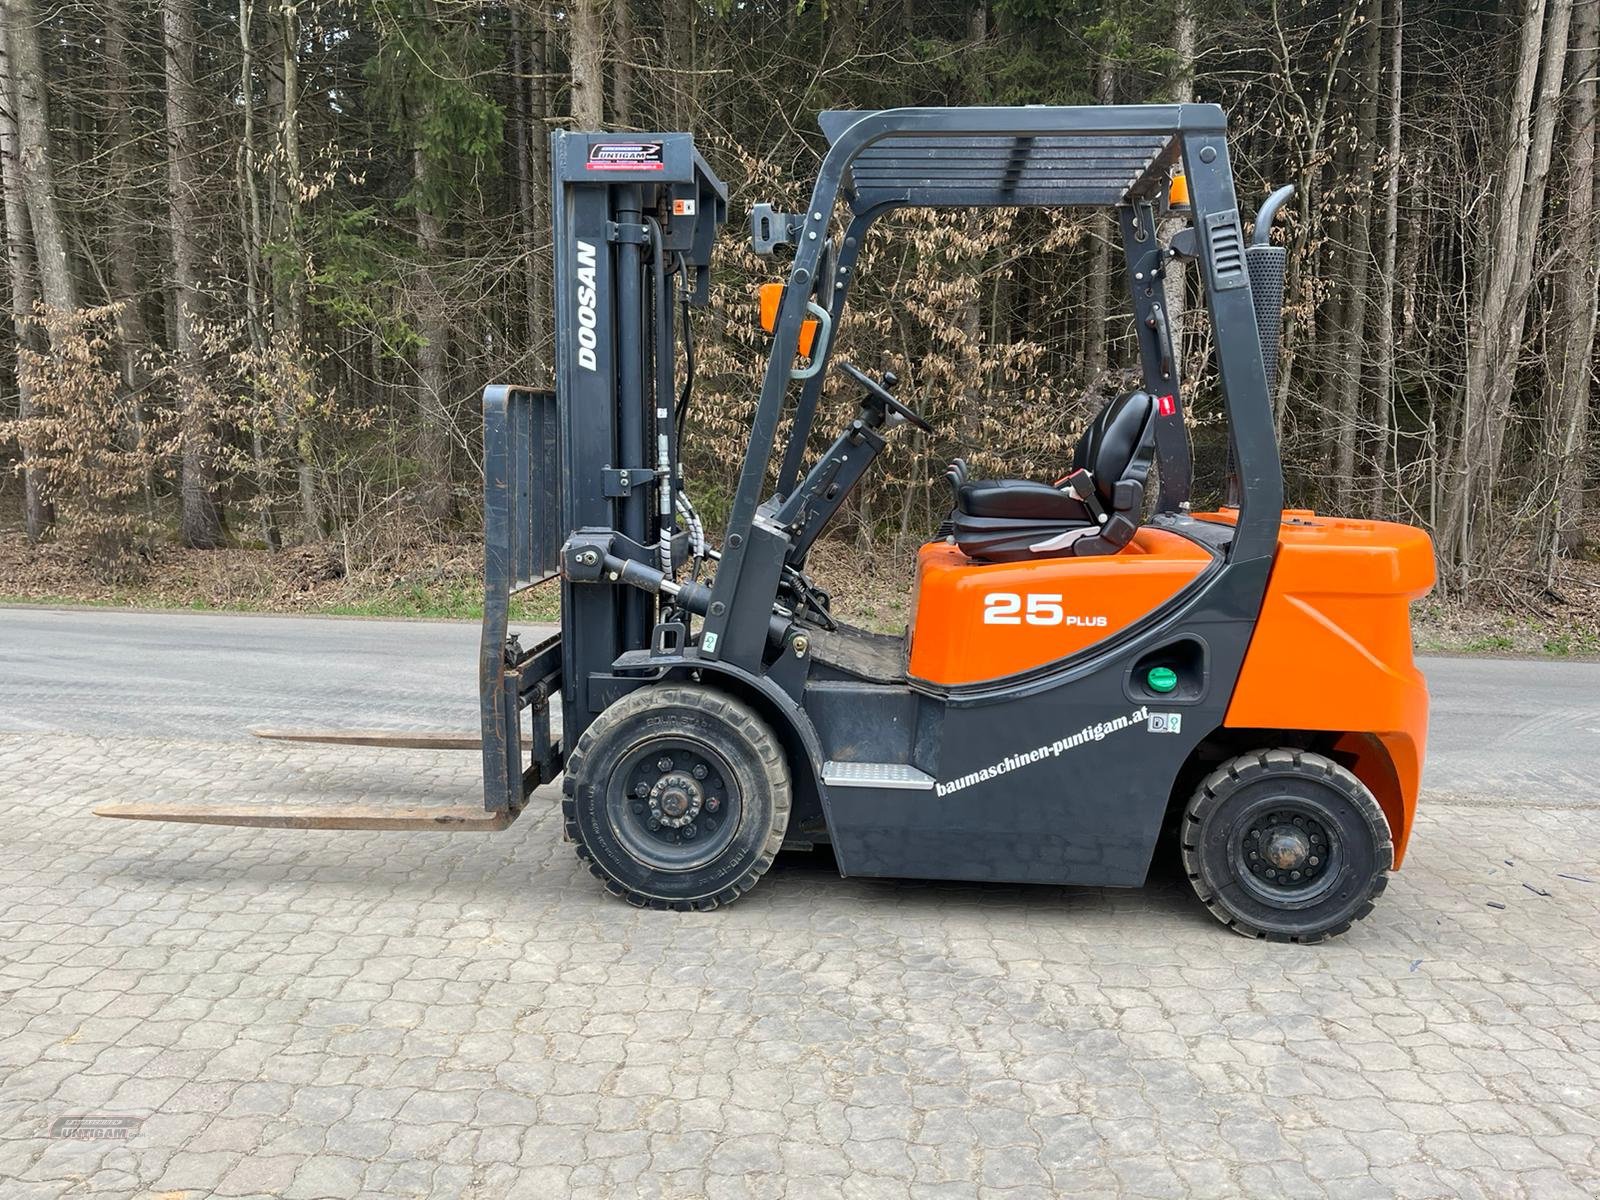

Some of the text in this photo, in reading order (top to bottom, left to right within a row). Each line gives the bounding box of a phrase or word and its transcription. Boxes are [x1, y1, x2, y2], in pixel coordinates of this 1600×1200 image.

[577, 241, 597, 372] DOOSAN
[984, 592, 1107, 627] 25 PLUS
[935, 705, 1150, 798] baumaschinen-puntigam.at
